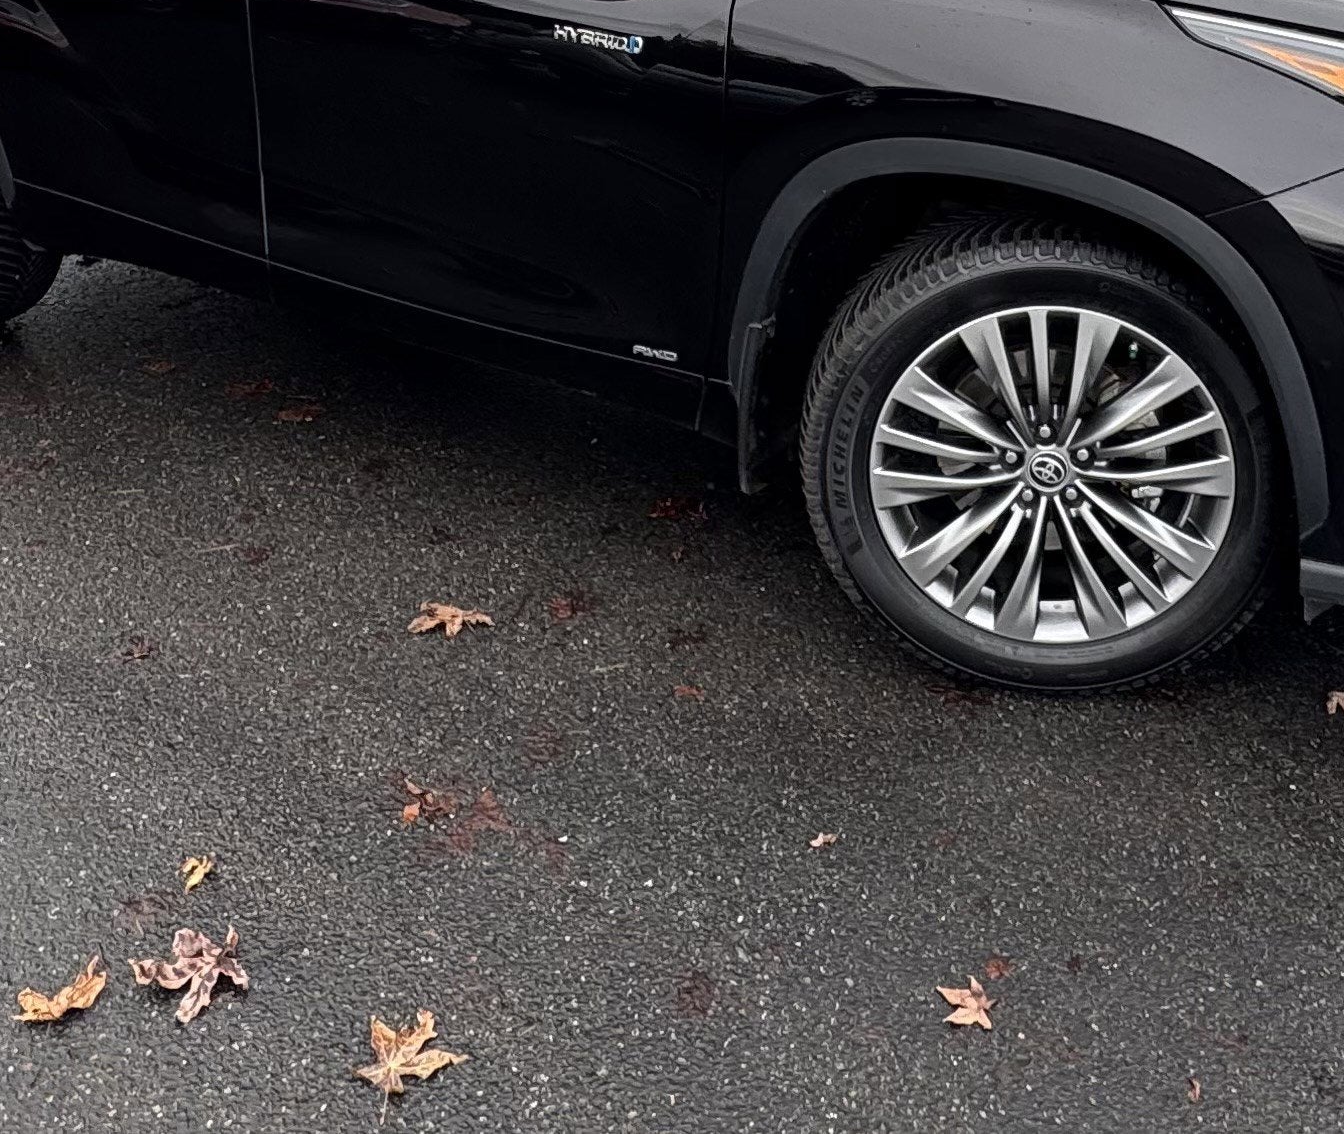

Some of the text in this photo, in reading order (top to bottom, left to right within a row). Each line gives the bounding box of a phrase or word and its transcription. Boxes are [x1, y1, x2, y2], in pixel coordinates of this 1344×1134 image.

[554, 24, 628, 50] HYBRID
[633, 345, 677, 362] AWD
[832, 385, 865, 509] MICHELIN
